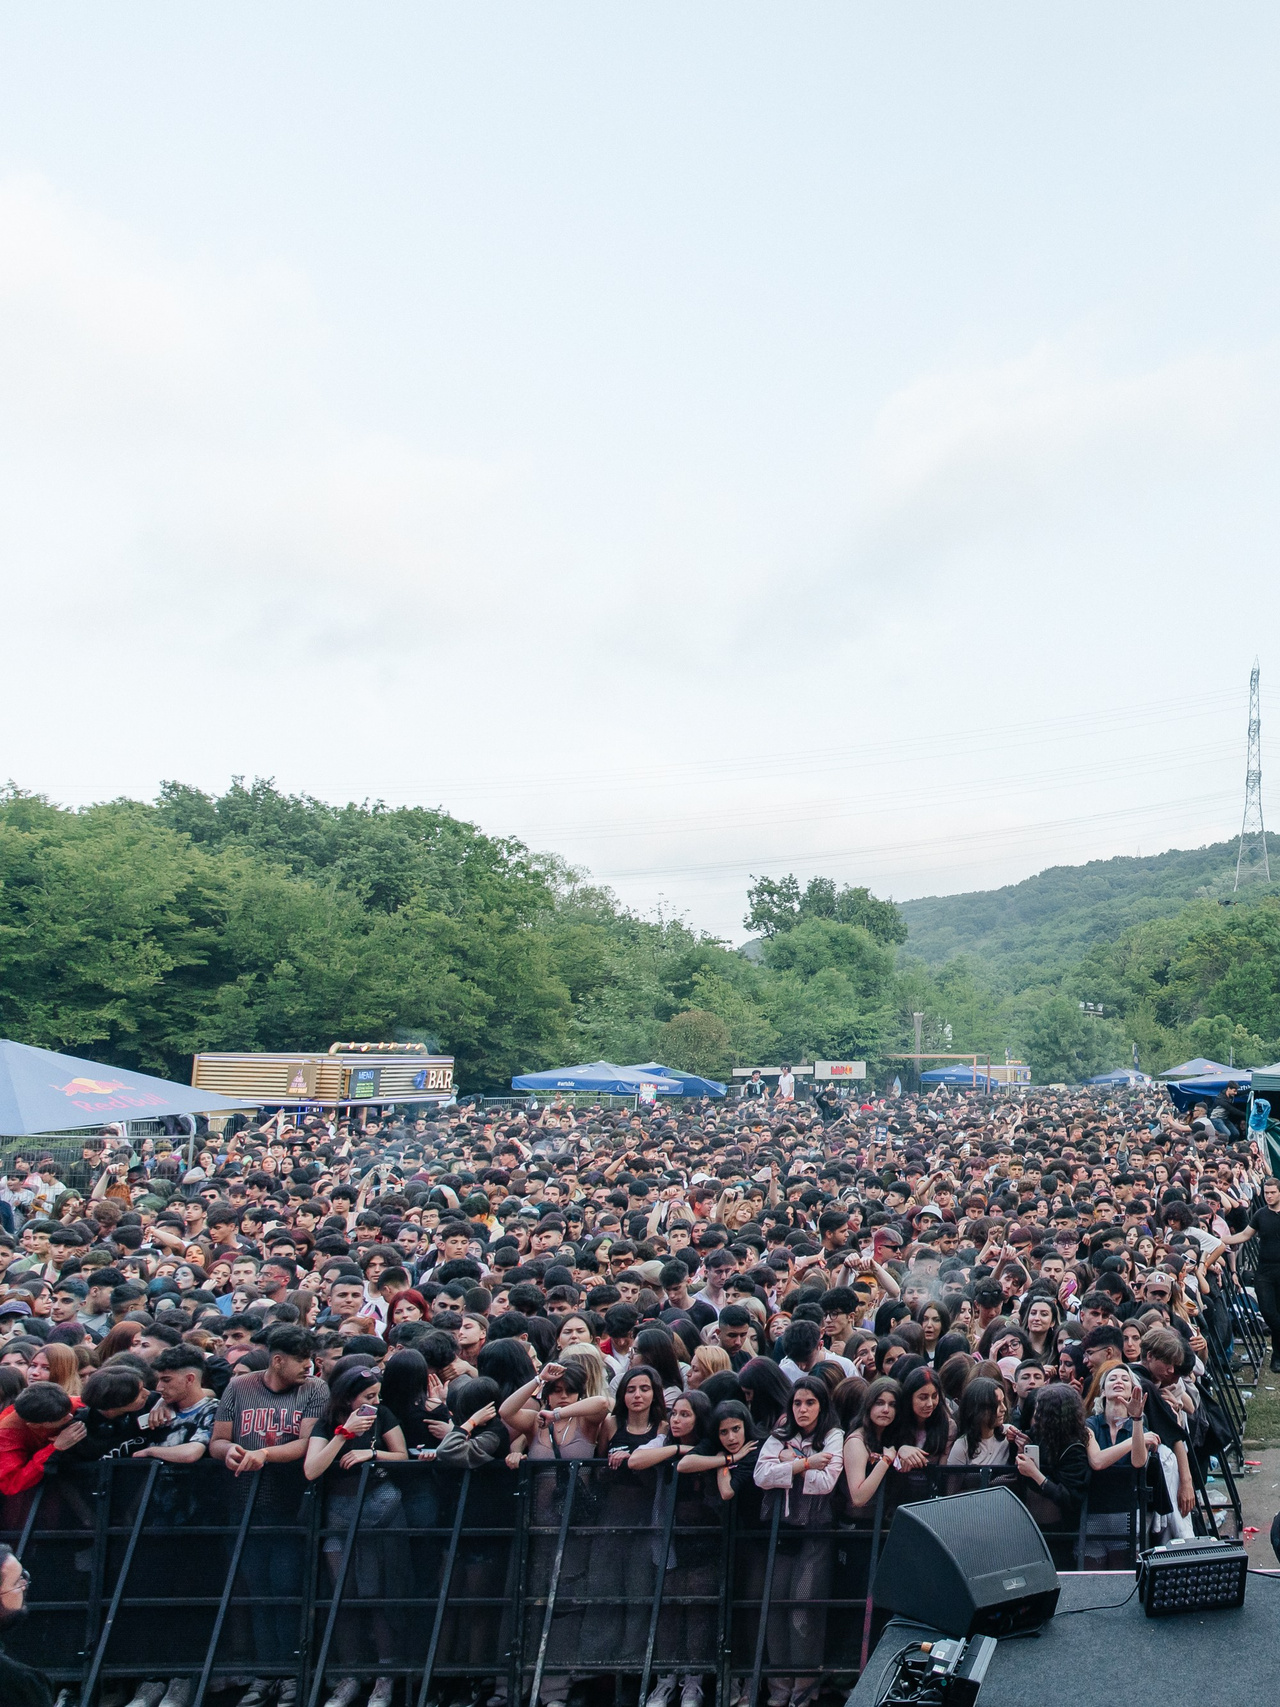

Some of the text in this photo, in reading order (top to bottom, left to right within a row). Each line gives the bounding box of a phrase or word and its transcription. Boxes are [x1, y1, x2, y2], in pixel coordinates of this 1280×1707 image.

[427, 1070, 453, 1089] BAR
[71, 1092, 169, 1112] Red Bull
[240, 1408, 303, 1437] BULLS
